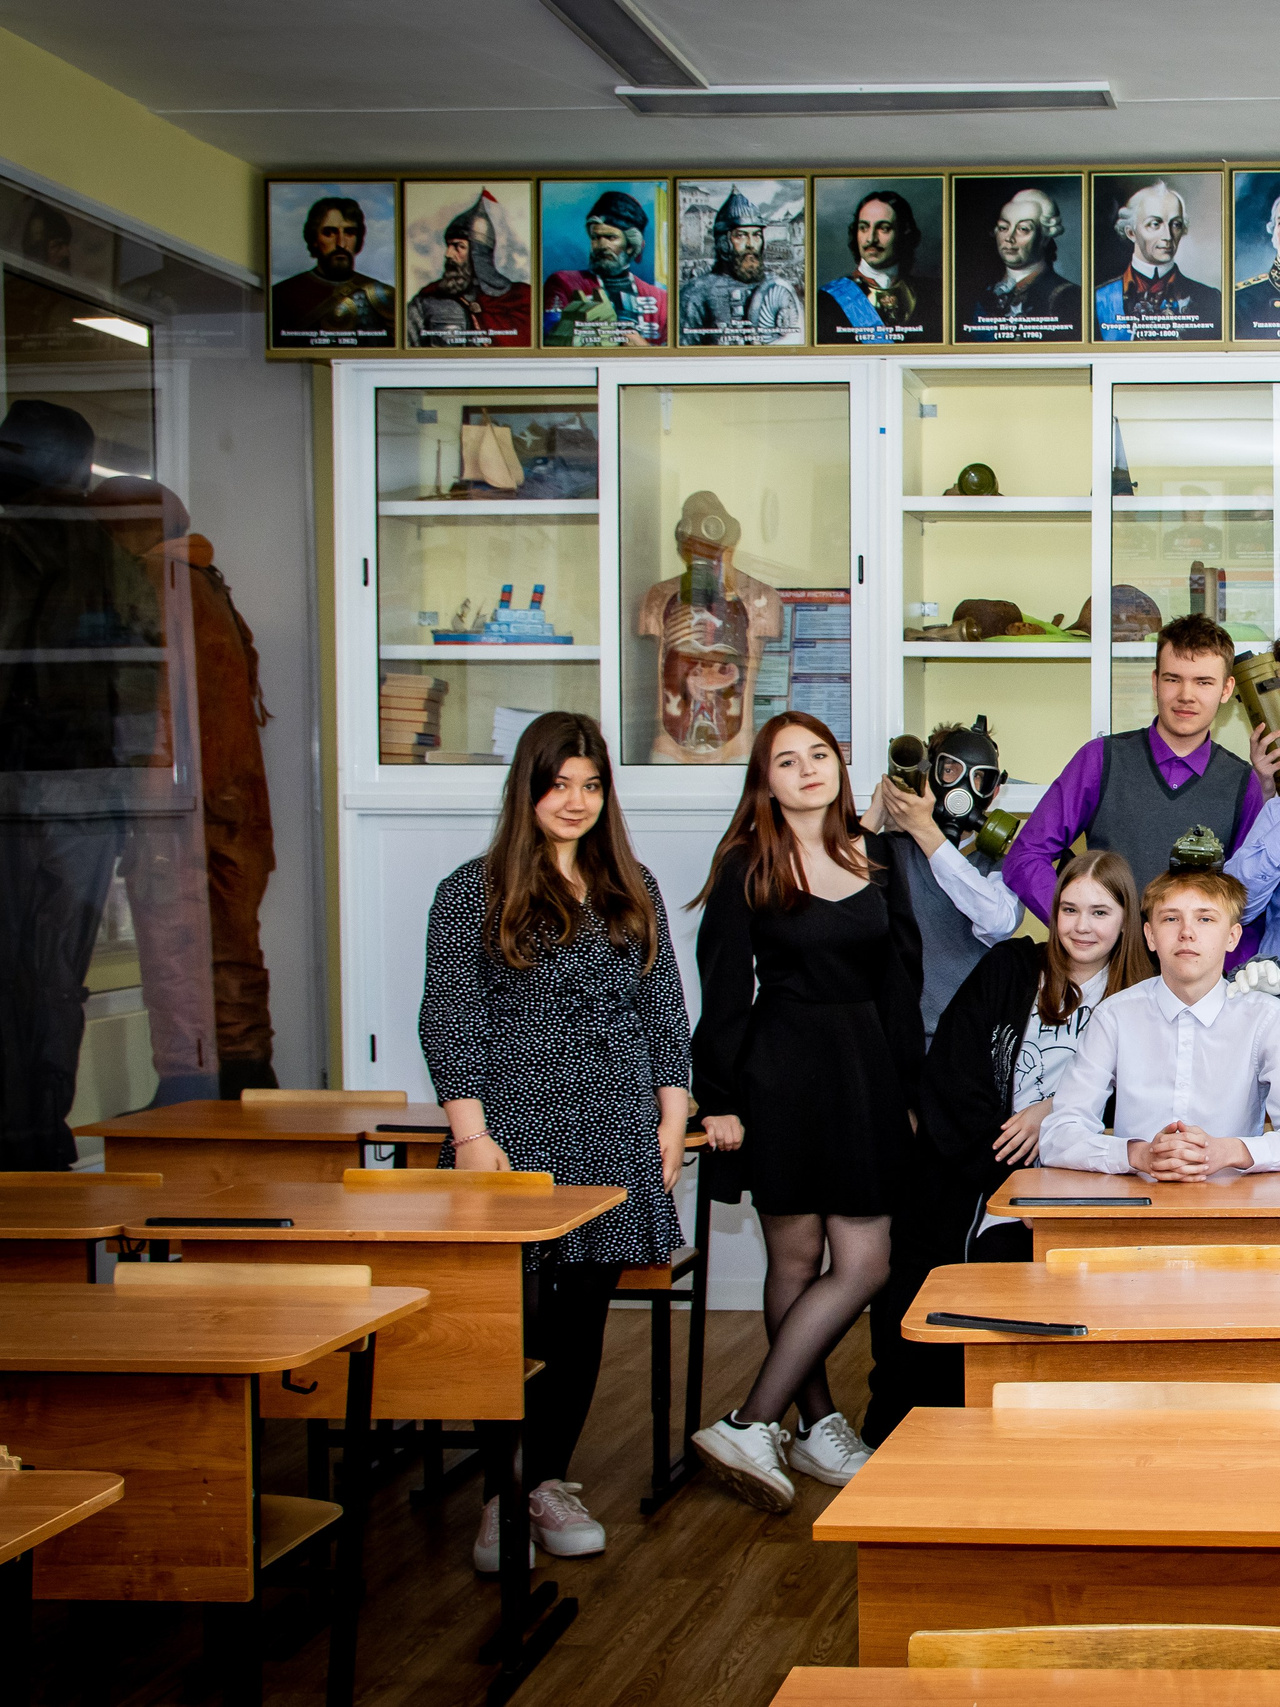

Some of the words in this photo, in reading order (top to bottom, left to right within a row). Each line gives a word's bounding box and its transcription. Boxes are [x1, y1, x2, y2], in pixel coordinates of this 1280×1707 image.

[963, 324, 997, 332] Румянцев
[999, 324, 1016, 332] Пётр
[1018, 324, 1073, 332] Александрович
[1253, 321, 1280, 329] Ушаков
